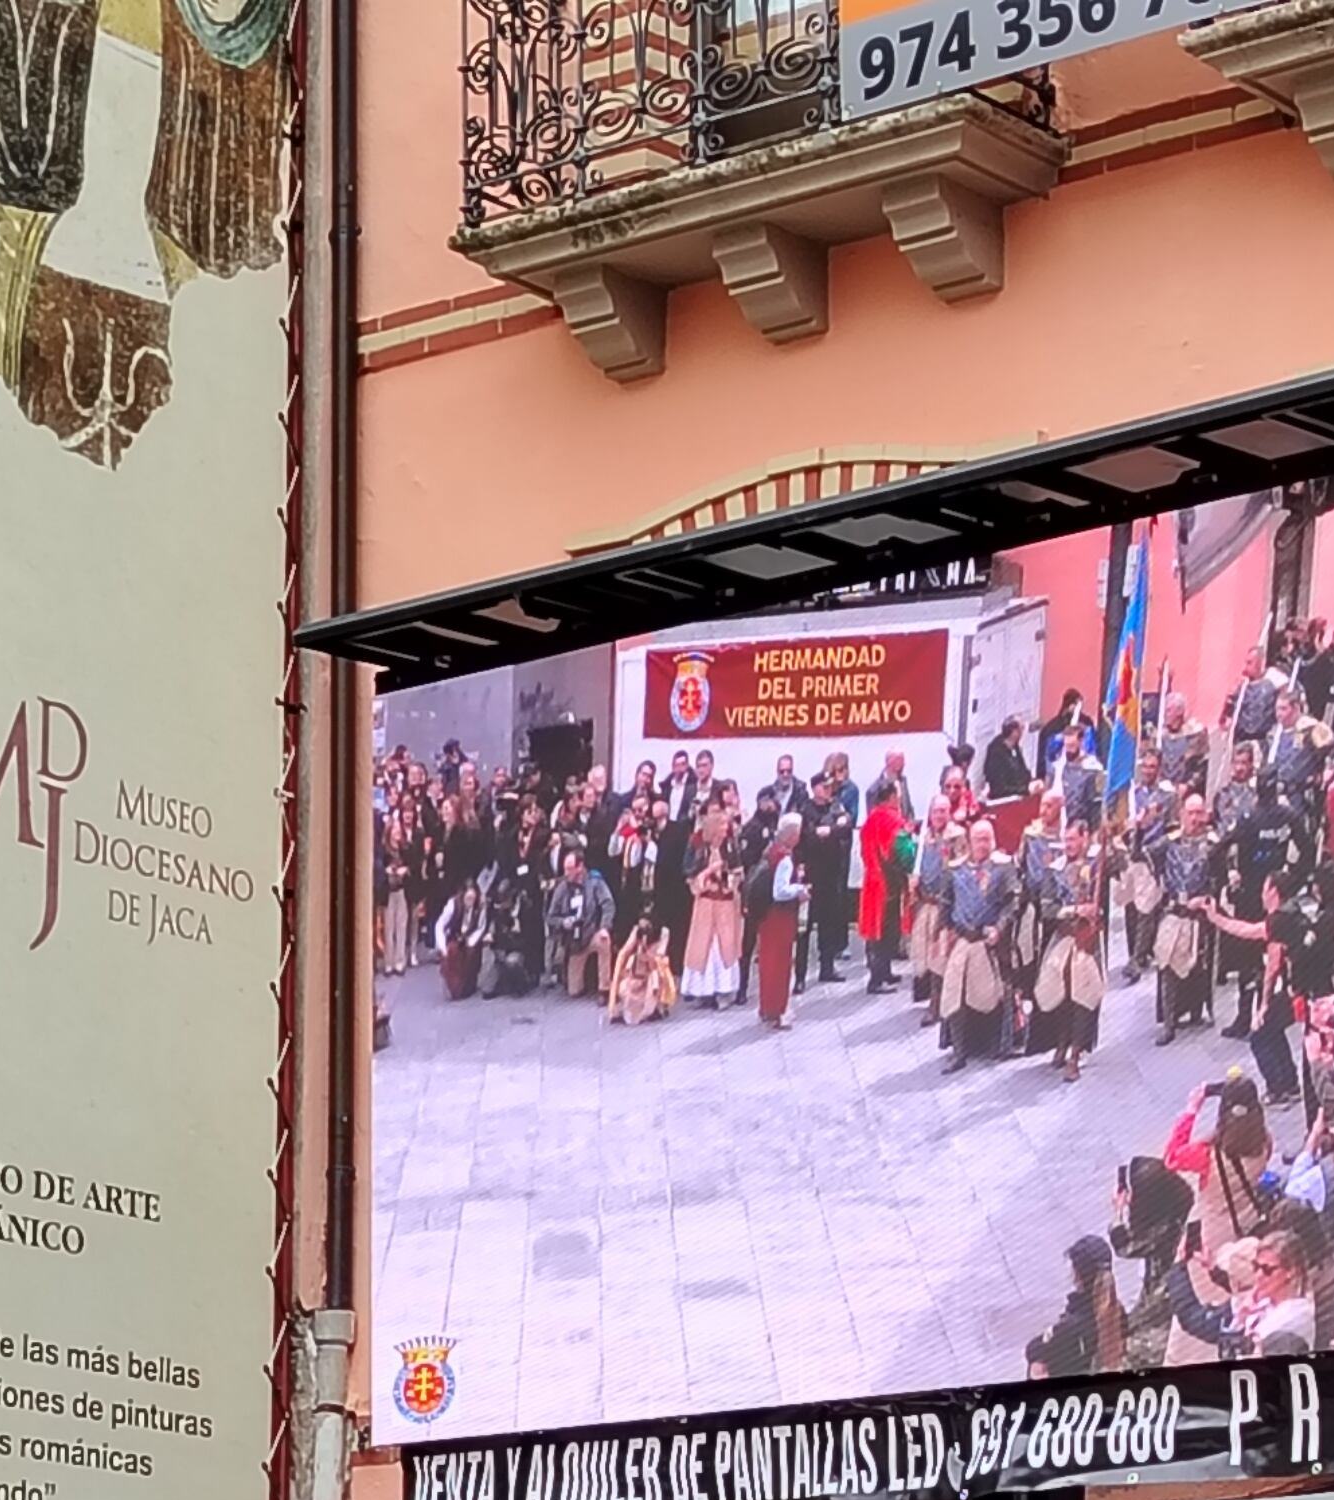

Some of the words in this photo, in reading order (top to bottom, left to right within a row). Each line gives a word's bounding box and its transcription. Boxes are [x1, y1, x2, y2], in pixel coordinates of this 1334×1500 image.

[859, 10, 976, 101] 974
[753, 644, 886, 673] HERMANDAD
[757, 676, 796, 699] DEL
[800, 673, 880, 699] PRIMER
[724, 704, 810, 729] VIERNES
[814, 703, 843, 727] DE
[847, 700, 912, 724] MAYO
[115, 779, 213, 839] MUSEO
[74, 819, 254, 902] DIOCESANO
[108, 889, 140, 927] DE
[147, 893, 213, 945] JACA
[32, 1169, 75, 1206] DE
[82, 1181, 162, 1223] ARTE
[22, 1333, 59, 1367] las
[66, 1344, 120, 1377] más
[127, 1350, 201, 1389] bellas
[72, 1392, 104, 1421] de
[111, 1399, 213, 1439] pinturas
[19, 1437, 153, 1477] románicas
[887, 1412, 945, 1493] LED
